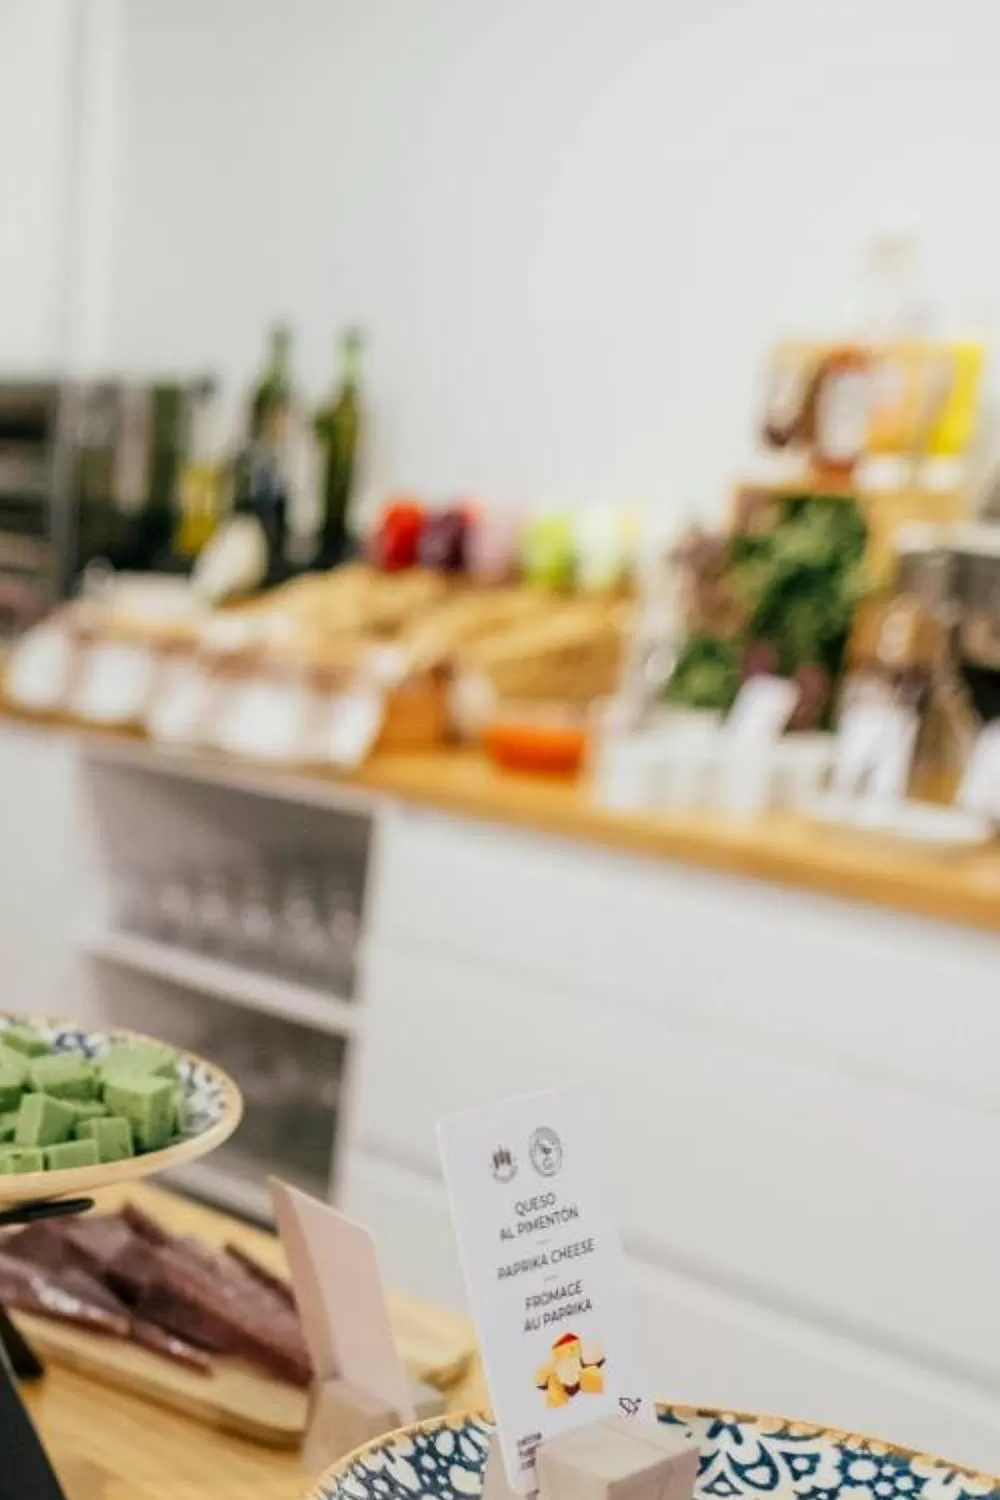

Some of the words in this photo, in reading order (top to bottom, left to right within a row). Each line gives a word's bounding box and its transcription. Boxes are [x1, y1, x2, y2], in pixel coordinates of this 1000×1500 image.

[514, 1191, 556, 1217] QUESO
[499, 1226, 516, 1242] AL
[497, 1252, 549, 1280] PAPRIKA
[550, 1238, 596, 1264] CHEESE
[523, 1315, 541, 1332] AU
[543, 1298, 593, 1325] PAPRIKA
